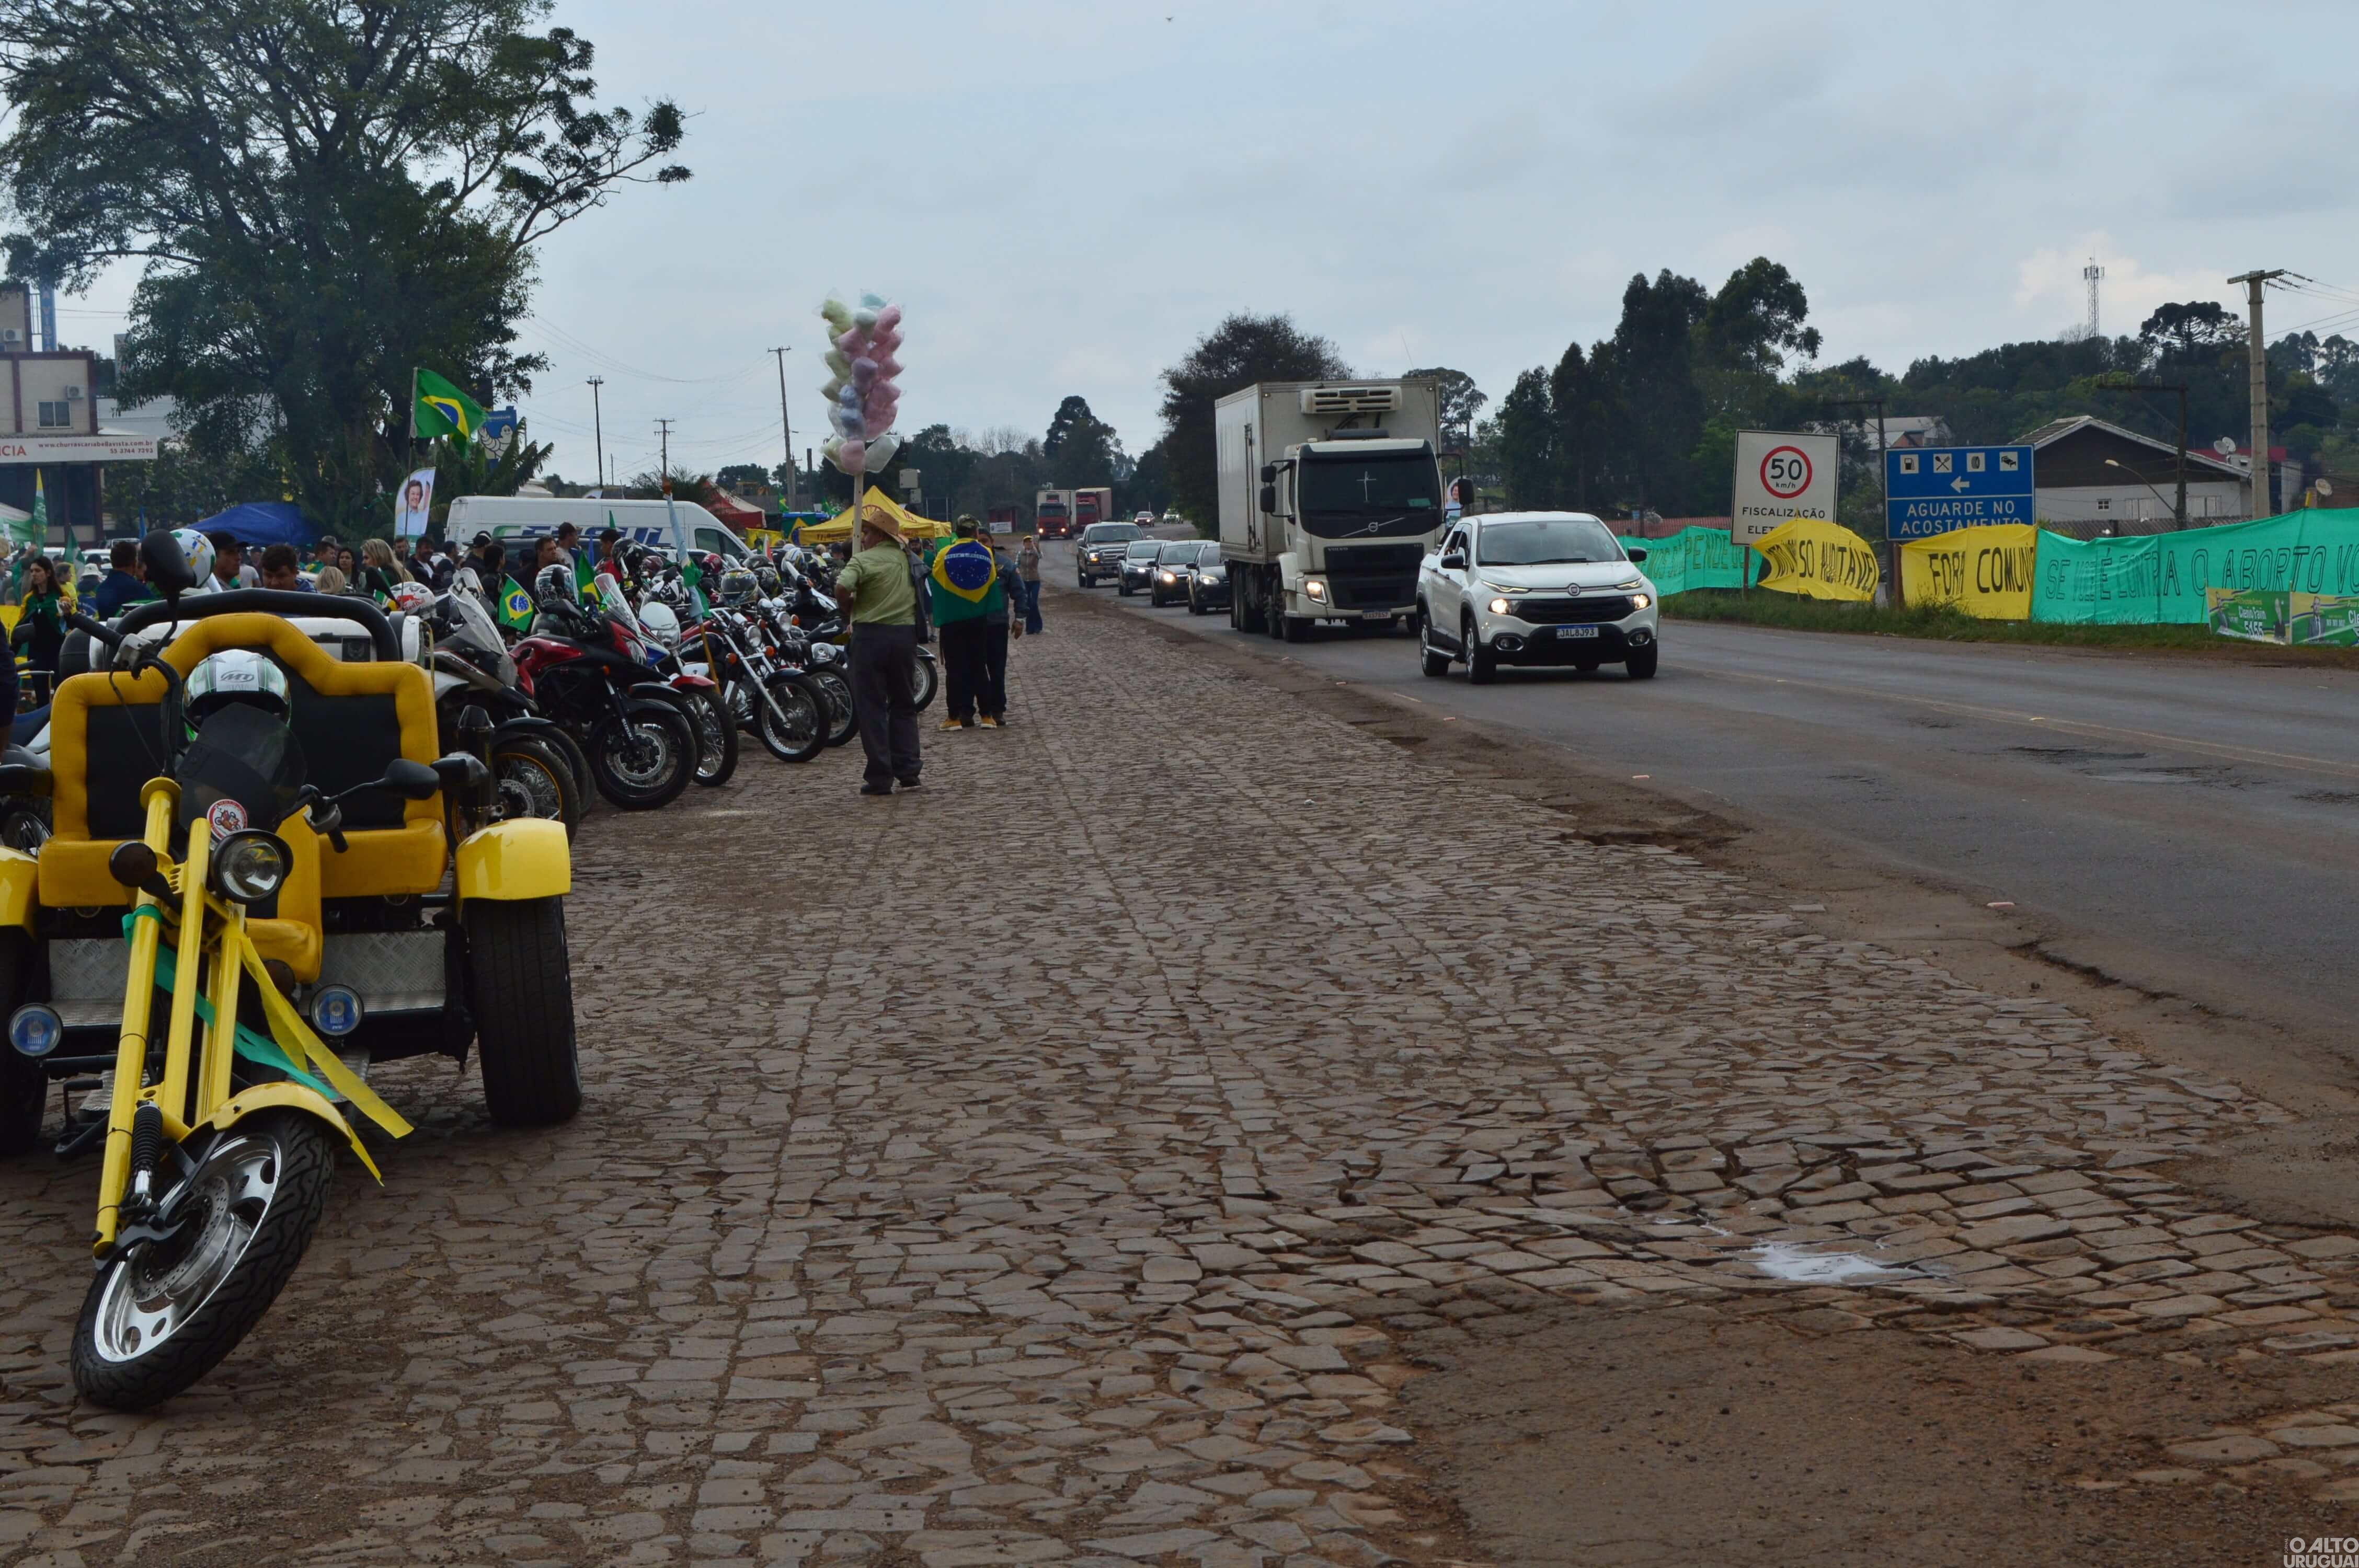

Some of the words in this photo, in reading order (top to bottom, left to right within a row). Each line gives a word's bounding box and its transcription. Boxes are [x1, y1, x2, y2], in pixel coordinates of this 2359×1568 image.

[0, 445, 27, 456] CIA
[1770, 458, 1802, 480] 50
[1742, 507, 1825, 519] FISCALIZAÇÃO
[1907, 501, 1984, 517] AGUARDE
[1993, 500, 2014, 514] NO
[1748, 525, 1777, 535] ELET
[1928, 550, 1966, 596] FORA
[2045, 559, 2071, 600] SE
[2191, 549, 2208, 597] O
[2222, 546, 2327, 594] ABORTO
[621, 718, 634, 741] SUZUKI
